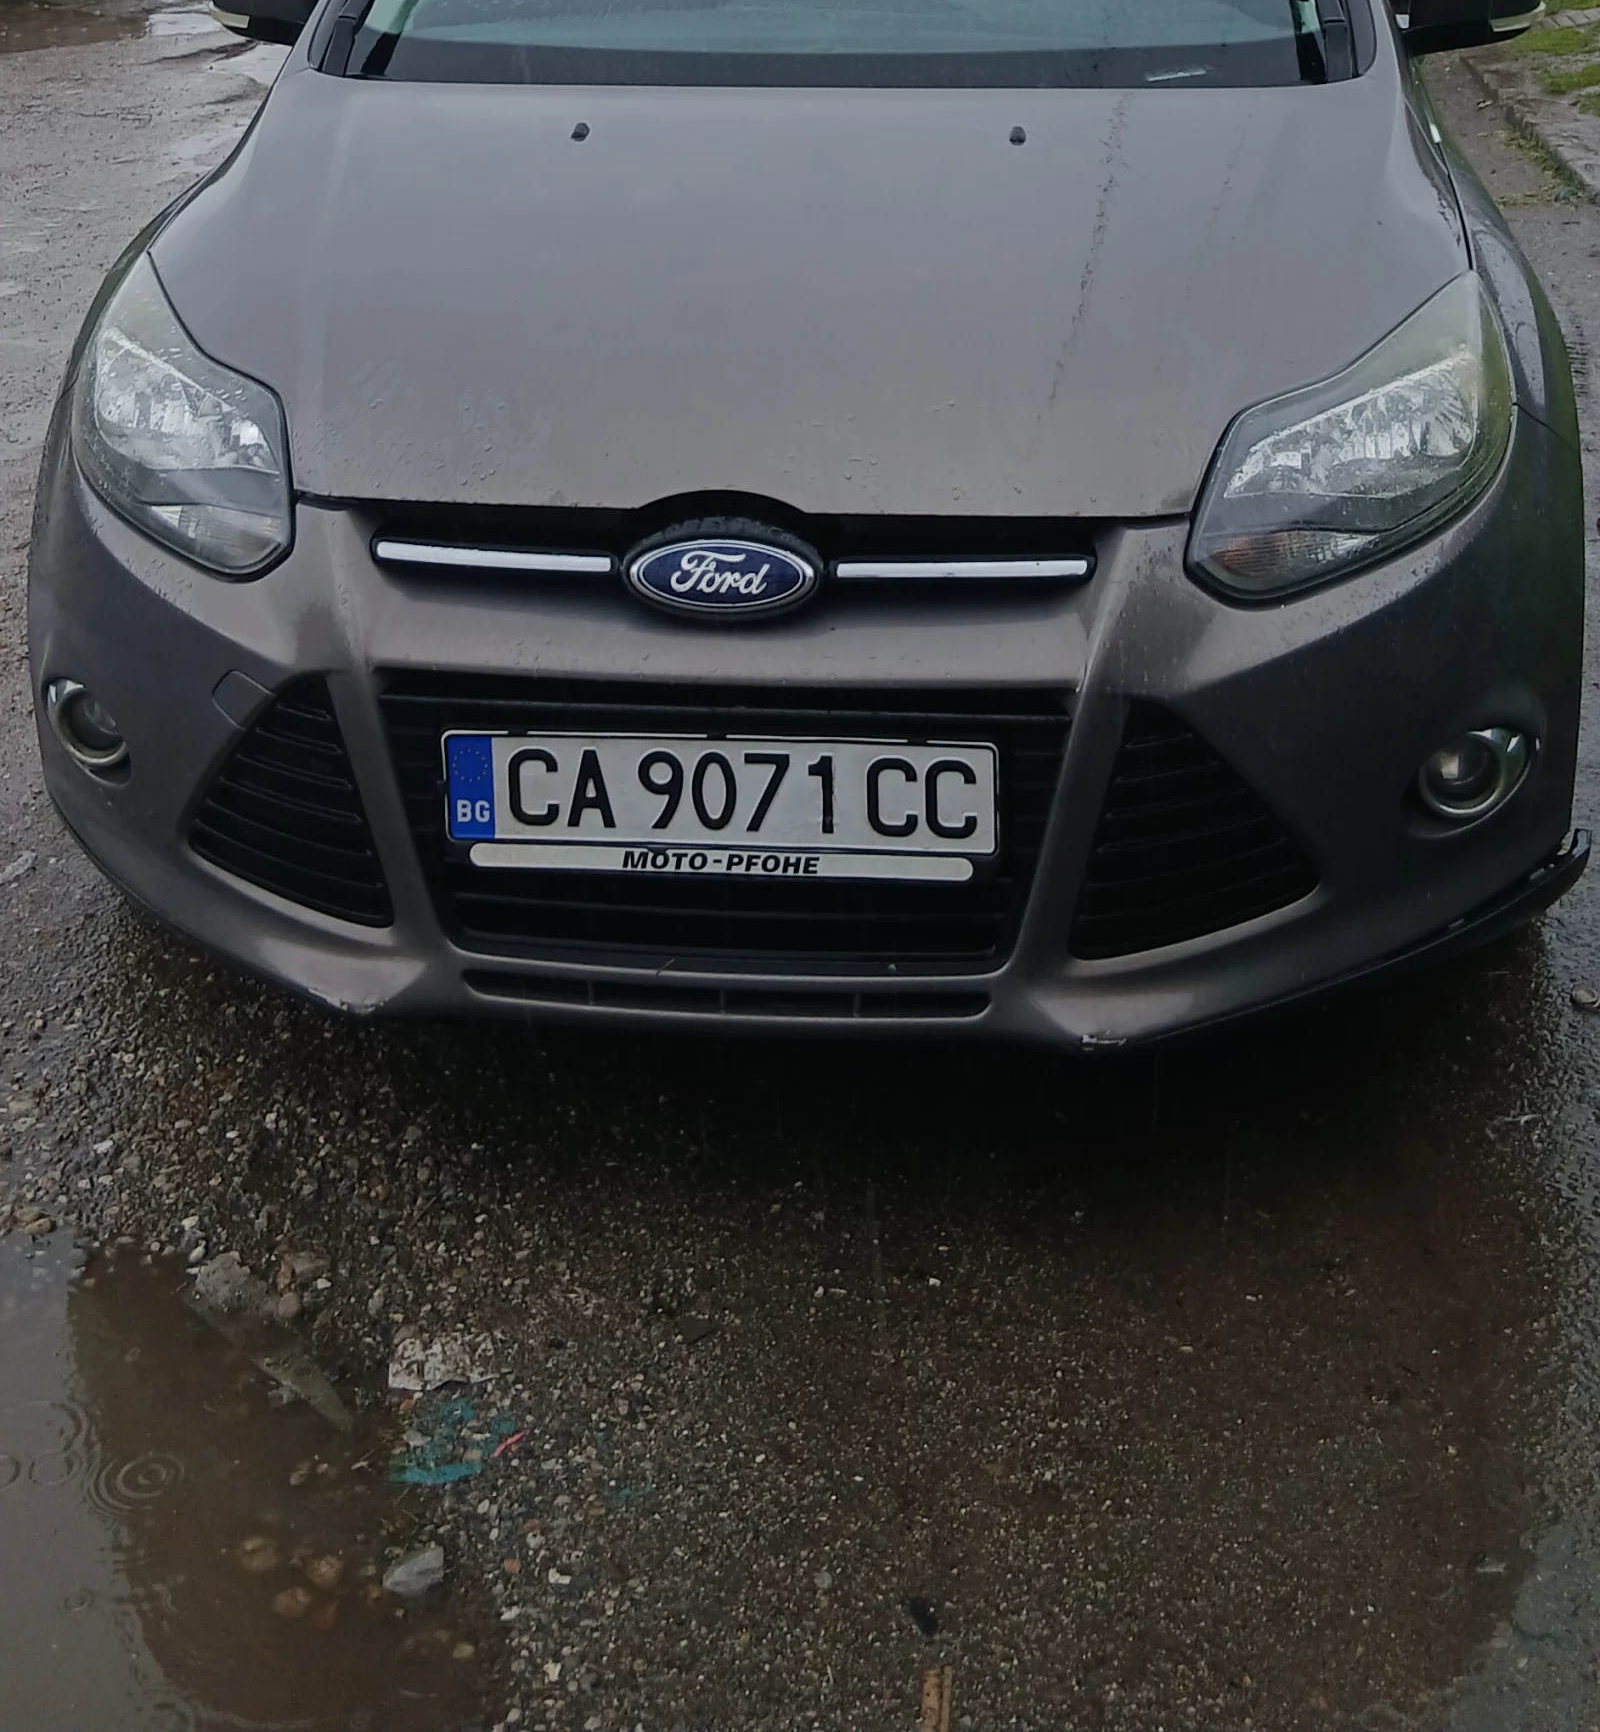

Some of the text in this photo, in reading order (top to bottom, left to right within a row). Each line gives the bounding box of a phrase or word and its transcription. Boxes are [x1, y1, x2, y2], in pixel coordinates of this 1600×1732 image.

[670, 550, 771, 595] Ford
[456, 799, 491, 823] BG
[507, 748, 978, 839] CA 9071 CC
